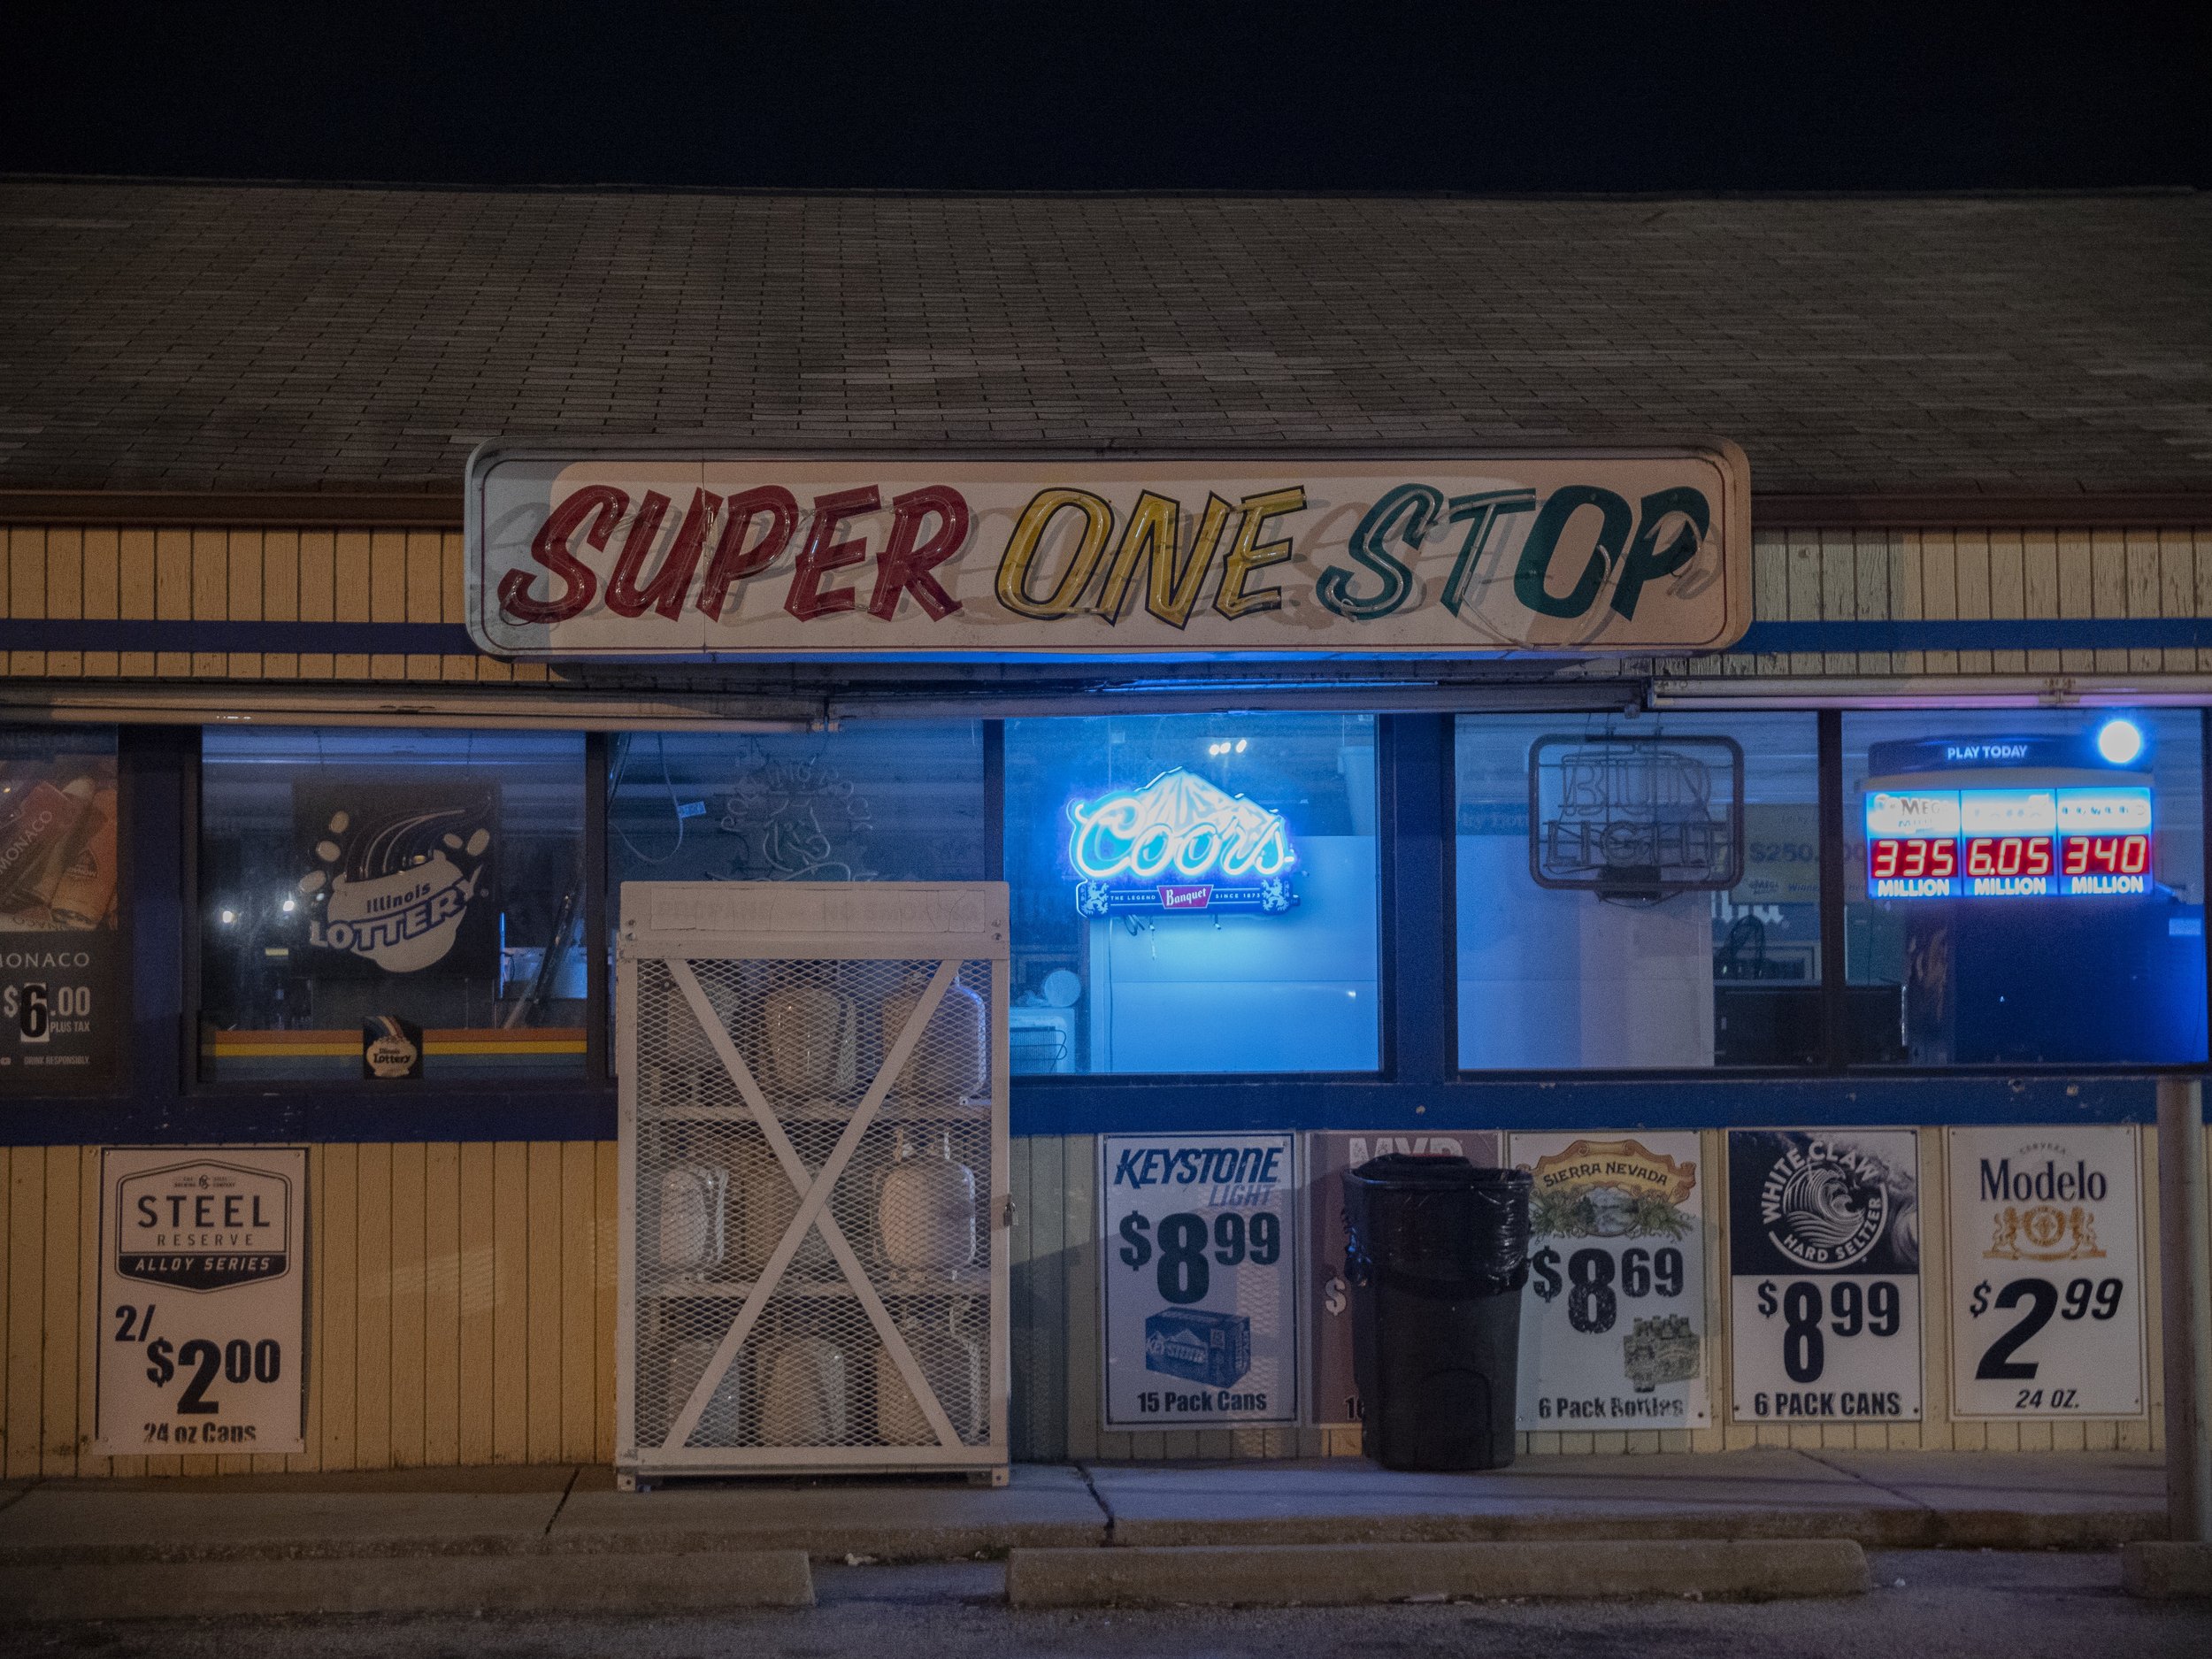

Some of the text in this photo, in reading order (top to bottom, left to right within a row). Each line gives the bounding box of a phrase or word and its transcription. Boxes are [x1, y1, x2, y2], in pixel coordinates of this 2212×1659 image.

[498, 483, 1710, 630] SUPER ONE STOP
[1947, 745, 2028, 760] PLAY TODAY
[1073, 798, 1294, 878] Coors
[1875, 839, 1954, 877] 335
[1969, 837, 2049, 876] 6.05
[2066, 835, 2147, 874] 340
[1166, 887, 1207, 907] Banquet
[1878, 879, 1950, 897] MILLION
[1974, 877, 2047, 896] MILLION
[2071, 875, 2144, 895] MILLION
[309, 864, 485, 950] LOTTERY
[366, 883, 431, 914] Illinois
[3, 984, 91, 1037] $6.00
[50, 1020, 91, 1033] PLUS TAX
[373, 1053, 411, 1064] Lottery
[1113, 1147, 1285, 1189] KEYSTONE
[1542, 1160, 1669, 1187] SIERRA NEVADA
[1980, 1157, 2108, 1202] Modelo
[1208, 1183, 1276, 1207] LIGHT
[1761, 1140, 1880, 1225] WHITE CLAW
[138, 1194, 271, 1229] STEEL
[157, 1233, 254, 1248] RESERVE
[1783, 1196, 1883, 1263] HARD SELTZER
[134, 1256, 271, 1271] ALLOY SERIES
[115, 1303, 157, 1342] 2/
[1138, 1390, 1267, 1413] 15 Pack Cans
[1539, 1397, 1552, 1418] 6
[1557, 1396, 1607, 1418] Pack
[1755, 1392, 1901, 1417] 6 PACK CANS
[2016, 1388, 2043, 1409] 24
[143, 1421, 257, 1444] 24 oz Cans
